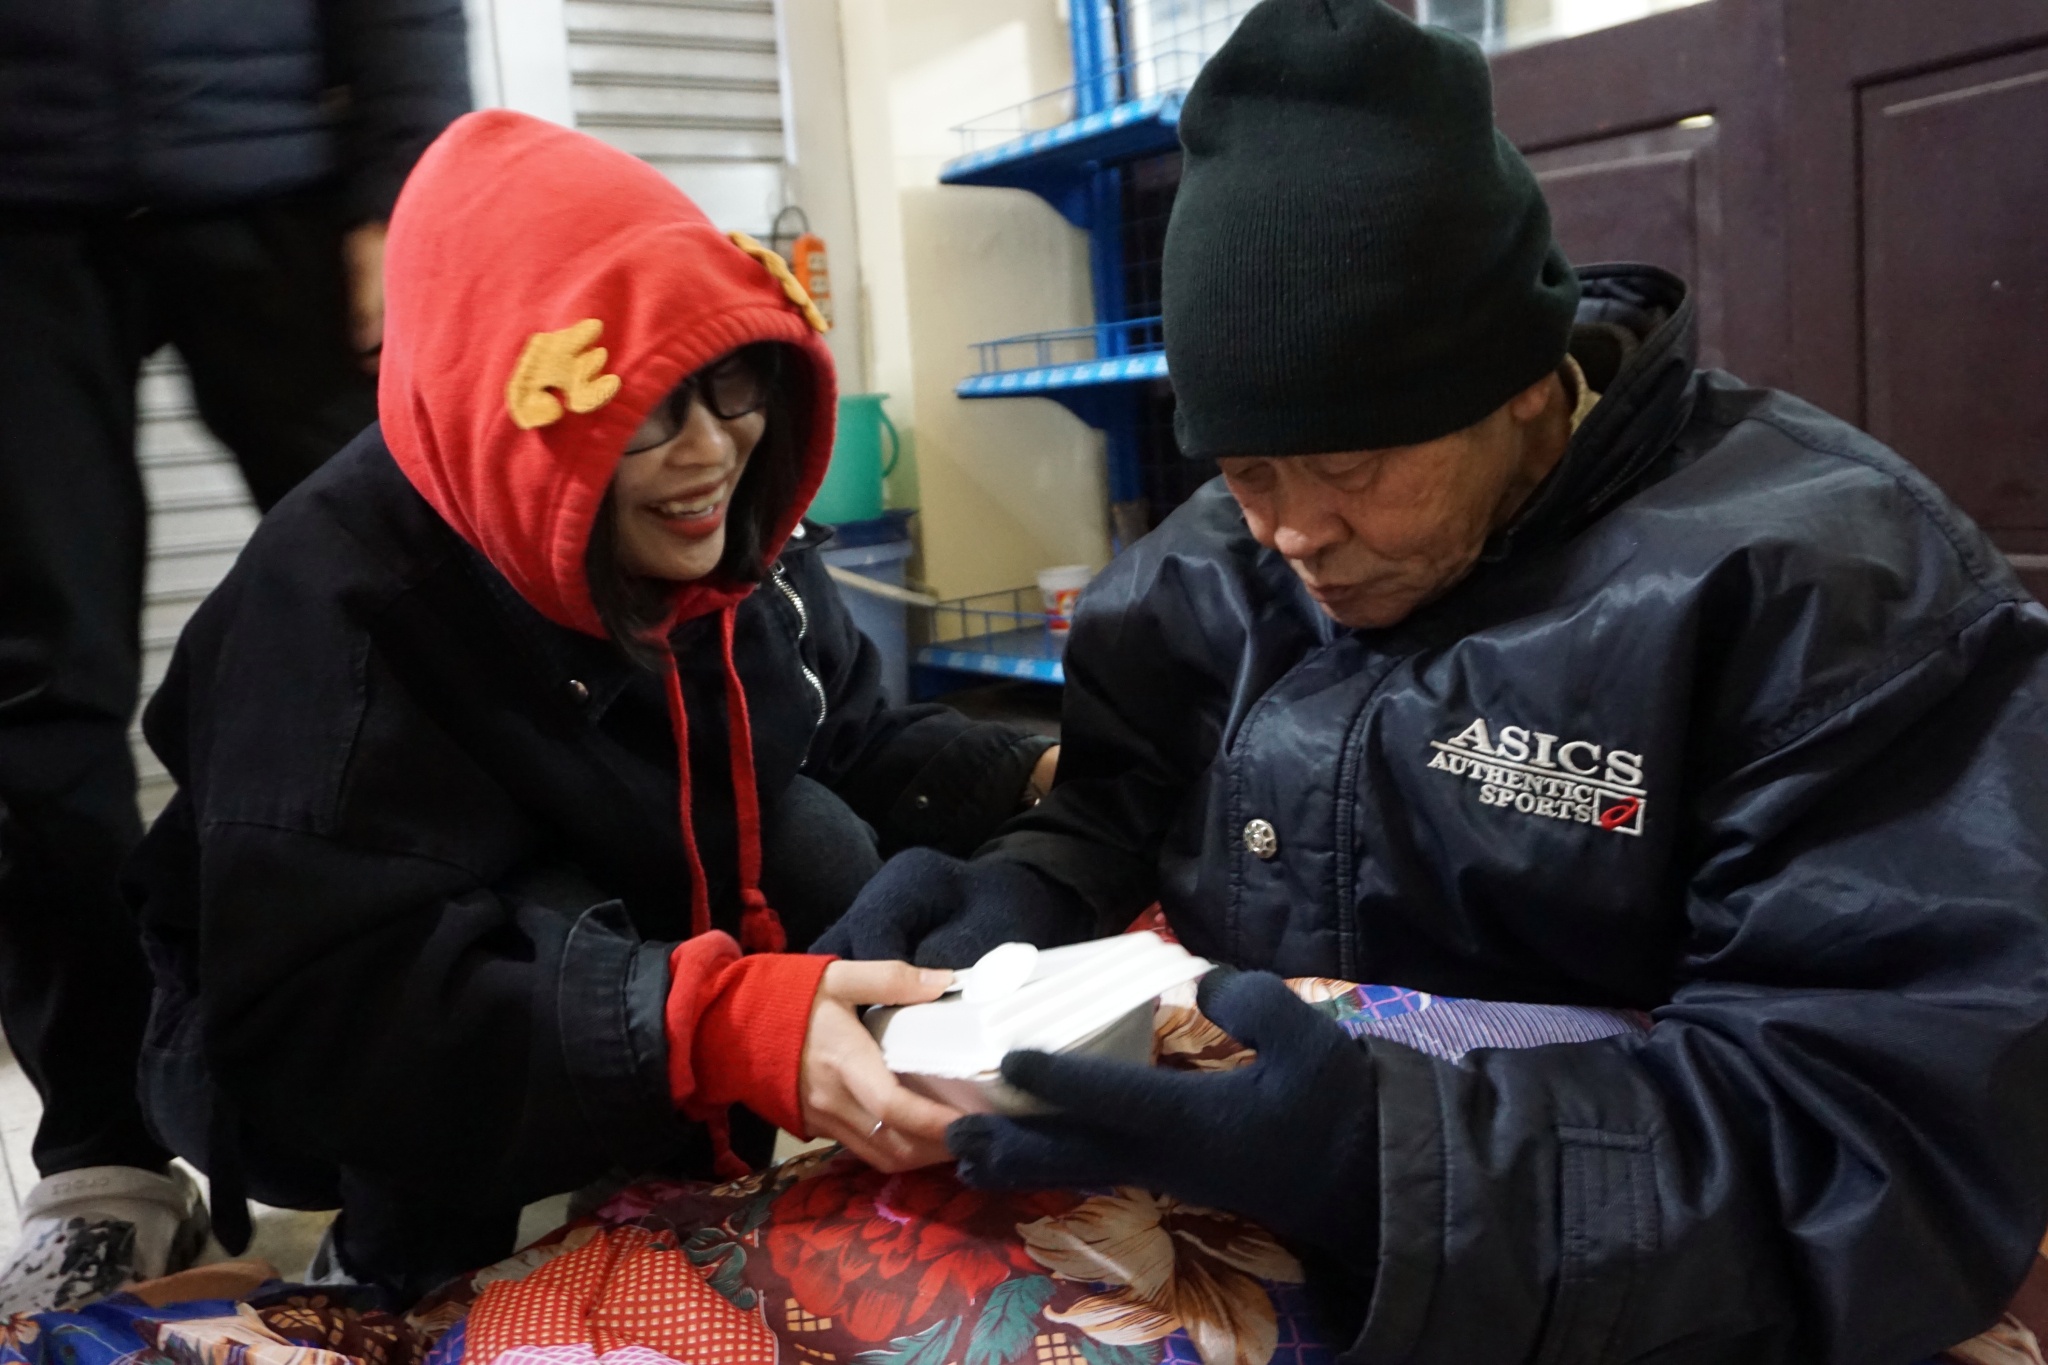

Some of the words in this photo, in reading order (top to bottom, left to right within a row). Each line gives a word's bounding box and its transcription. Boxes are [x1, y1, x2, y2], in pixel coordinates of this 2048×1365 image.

[1427, 751, 1594, 803] AUTHENTIC
[1448, 718, 1643, 786] ASICS
[1479, 784, 1592, 823] SPORTS
